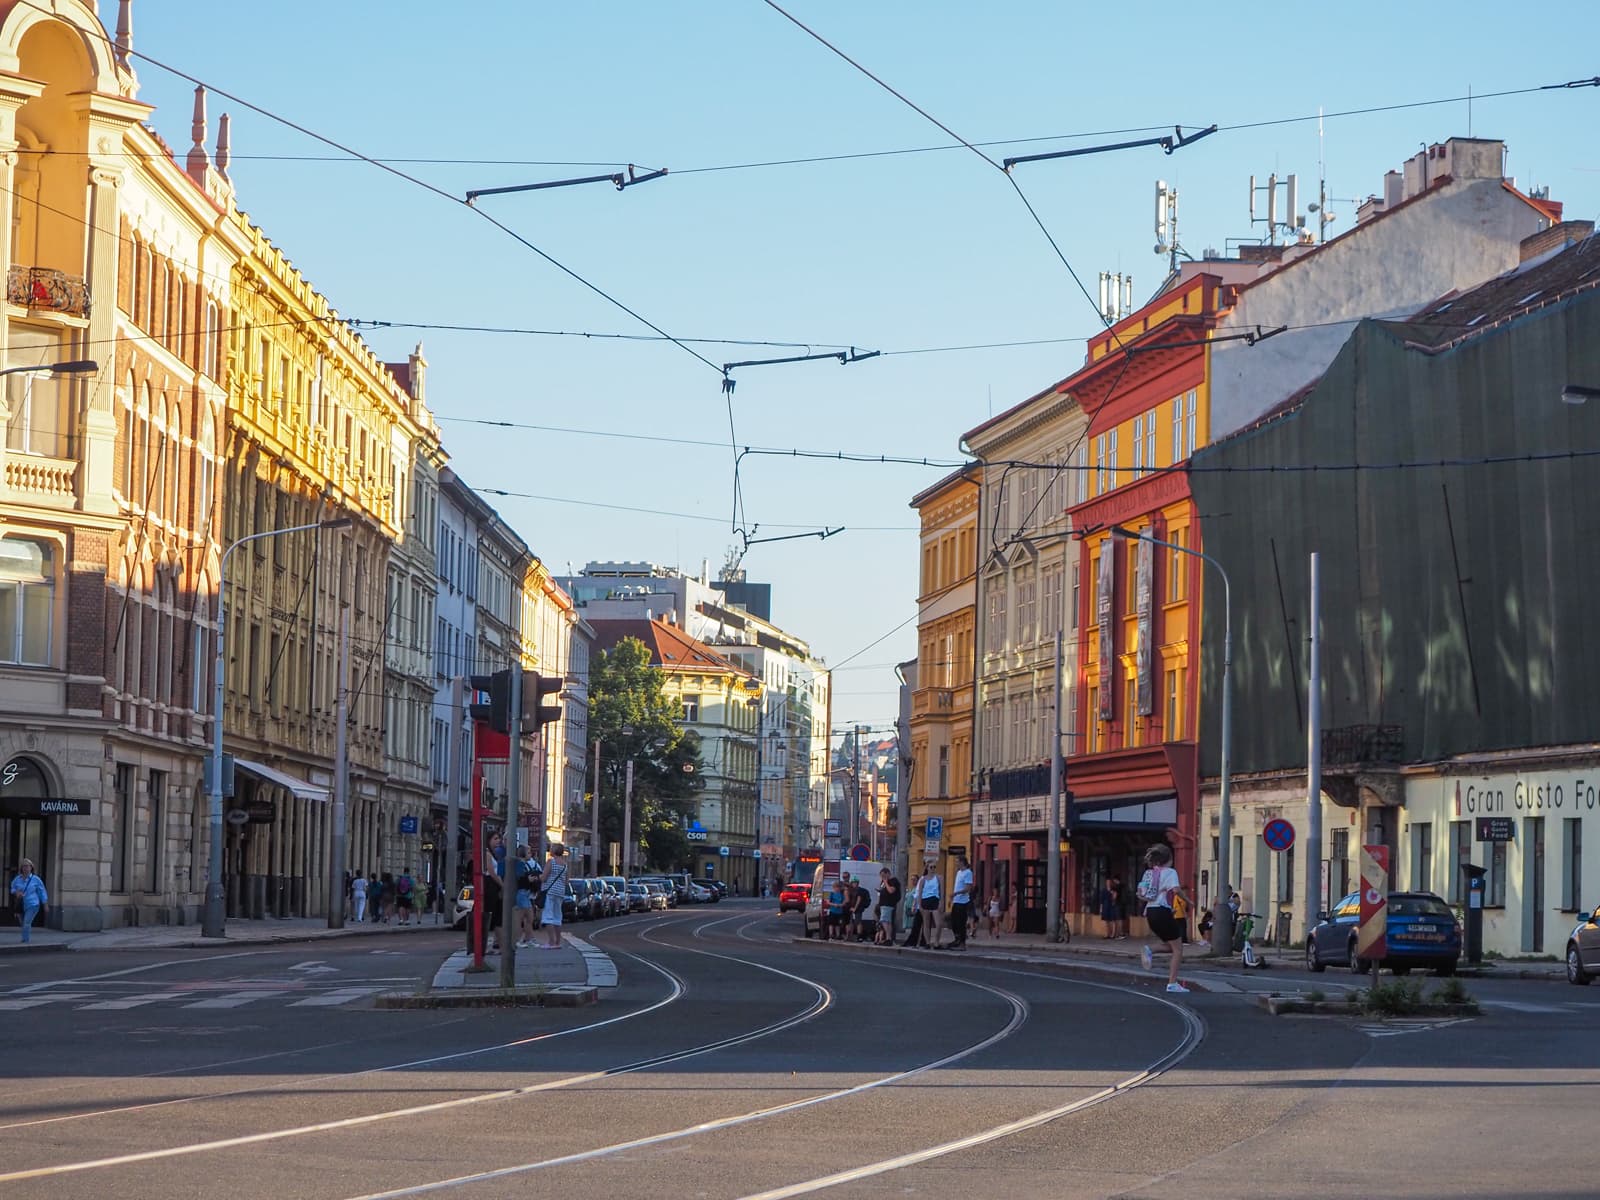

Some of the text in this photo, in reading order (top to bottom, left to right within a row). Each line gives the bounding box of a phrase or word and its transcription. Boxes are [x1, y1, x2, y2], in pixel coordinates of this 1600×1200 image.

[1466, 780, 1600, 813] Gran Gusto Fo
[41, 800, 79, 812] KAVÁRNA
[930, 819, 940, 832] P
[1472, 878, 1478, 888] P
